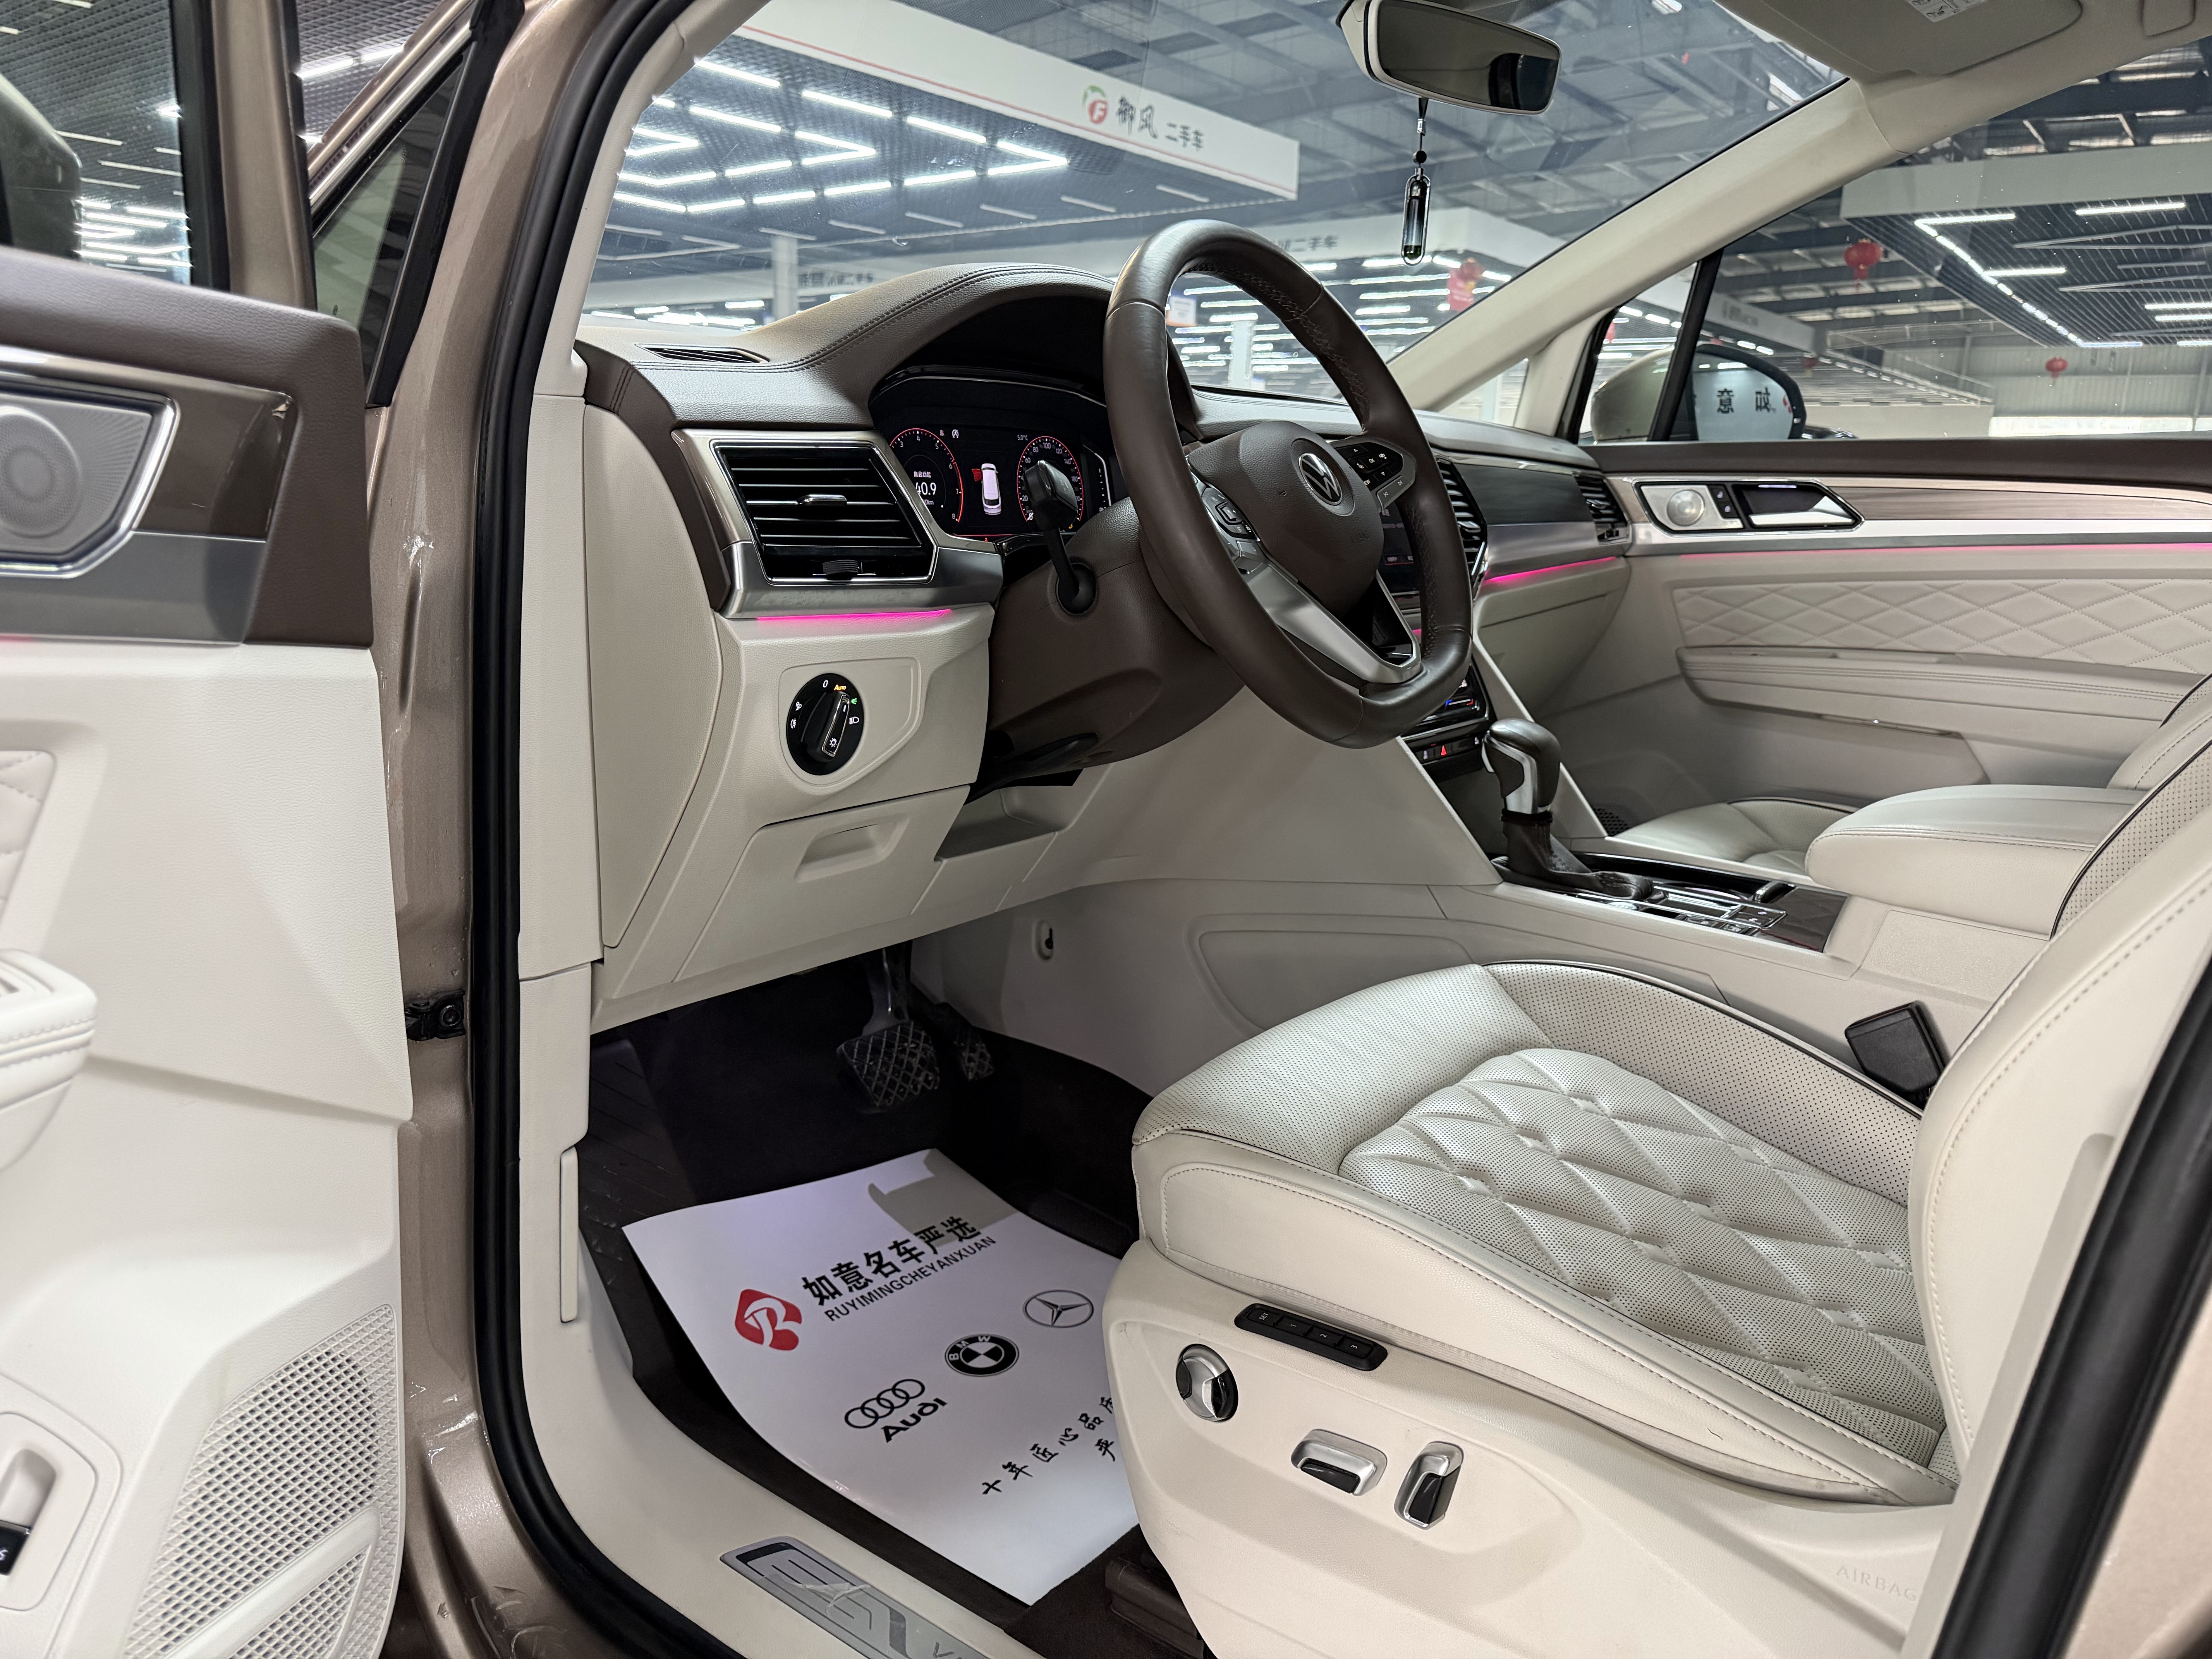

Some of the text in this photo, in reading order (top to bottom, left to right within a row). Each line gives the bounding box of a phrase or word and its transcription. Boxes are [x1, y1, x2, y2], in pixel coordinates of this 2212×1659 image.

[1165, 122, 1205, 151] 二手车
[915, 482, 936, 495] 40.9
[801, 1216, 981, 1306] 如意名车严选
[824, 1237, 996, 1321] RUYIMINGCHEYANXUAN
[949, 1336, 991, 1361] BMW
[1836, 1565, 1917, 1601] AIRBAG
